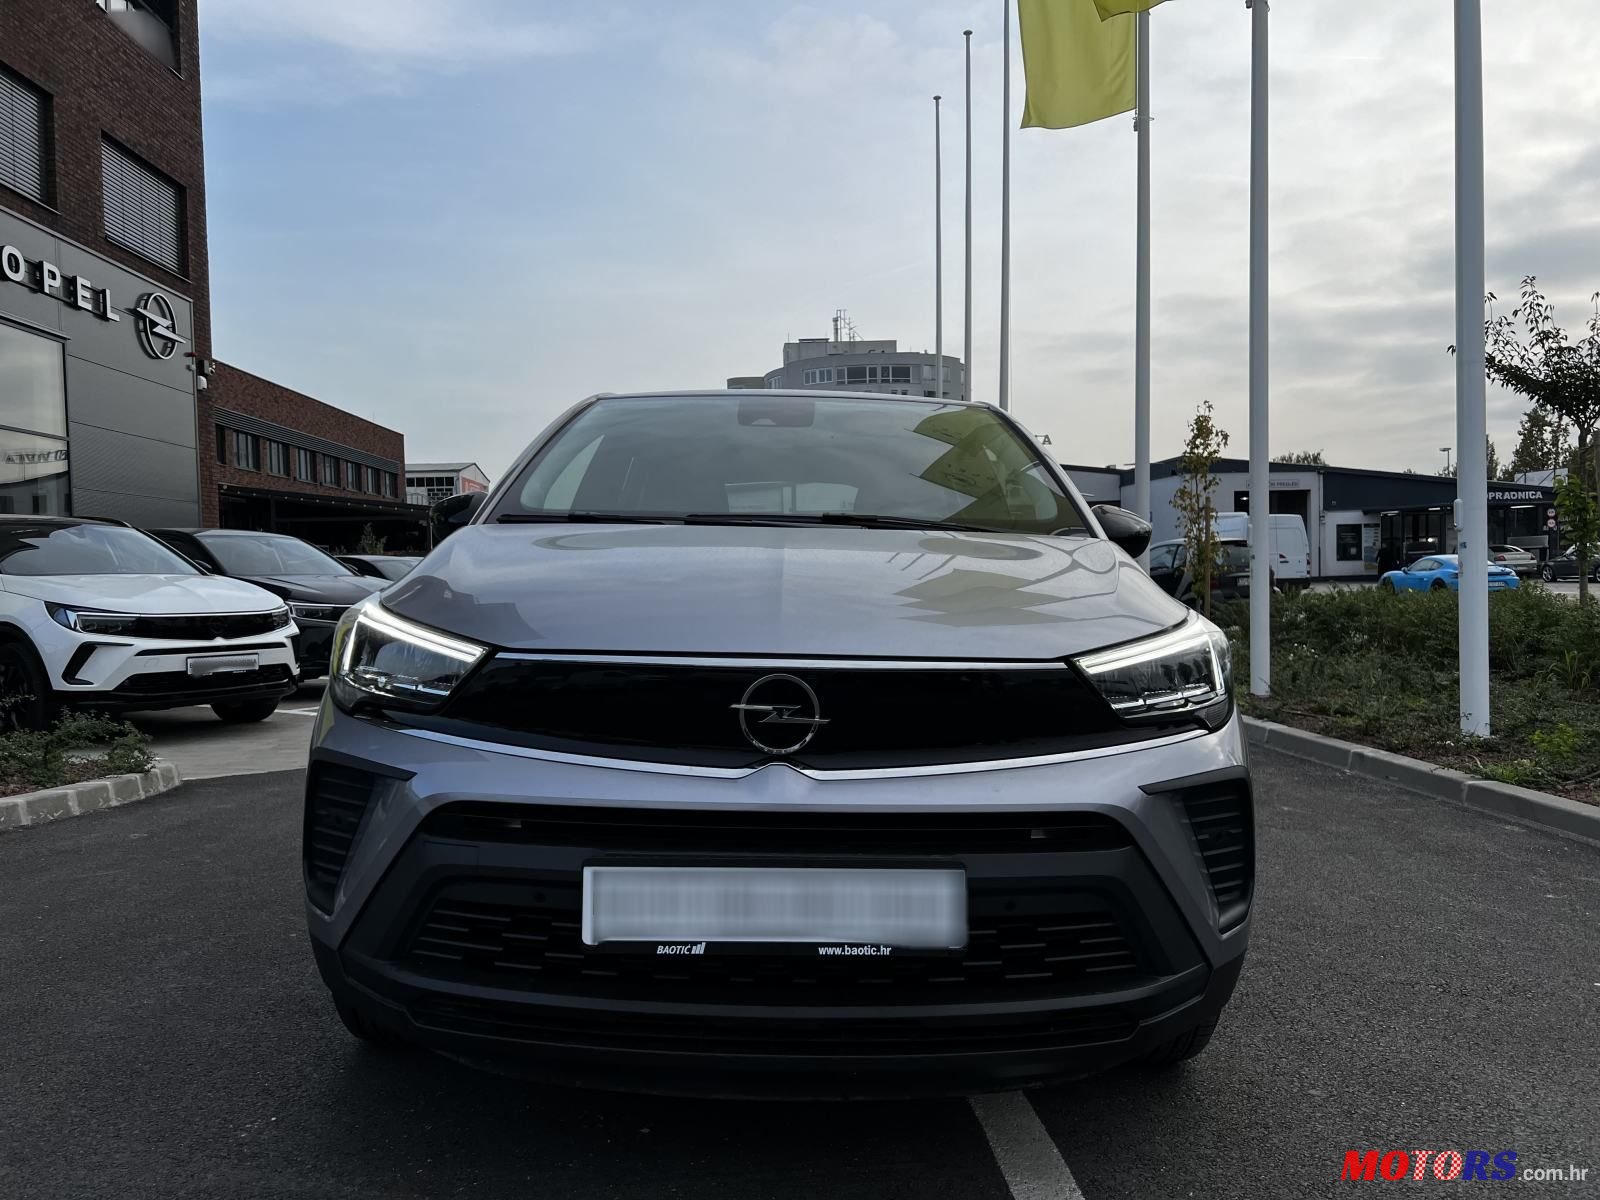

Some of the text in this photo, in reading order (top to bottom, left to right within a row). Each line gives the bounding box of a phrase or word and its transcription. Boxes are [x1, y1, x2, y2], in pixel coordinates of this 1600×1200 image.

[1, 245, 120, 322] OPEL
[1487, 490, 1543, 500] PRAONICA
[818, 944, 892, 955] www.baotic.hr
